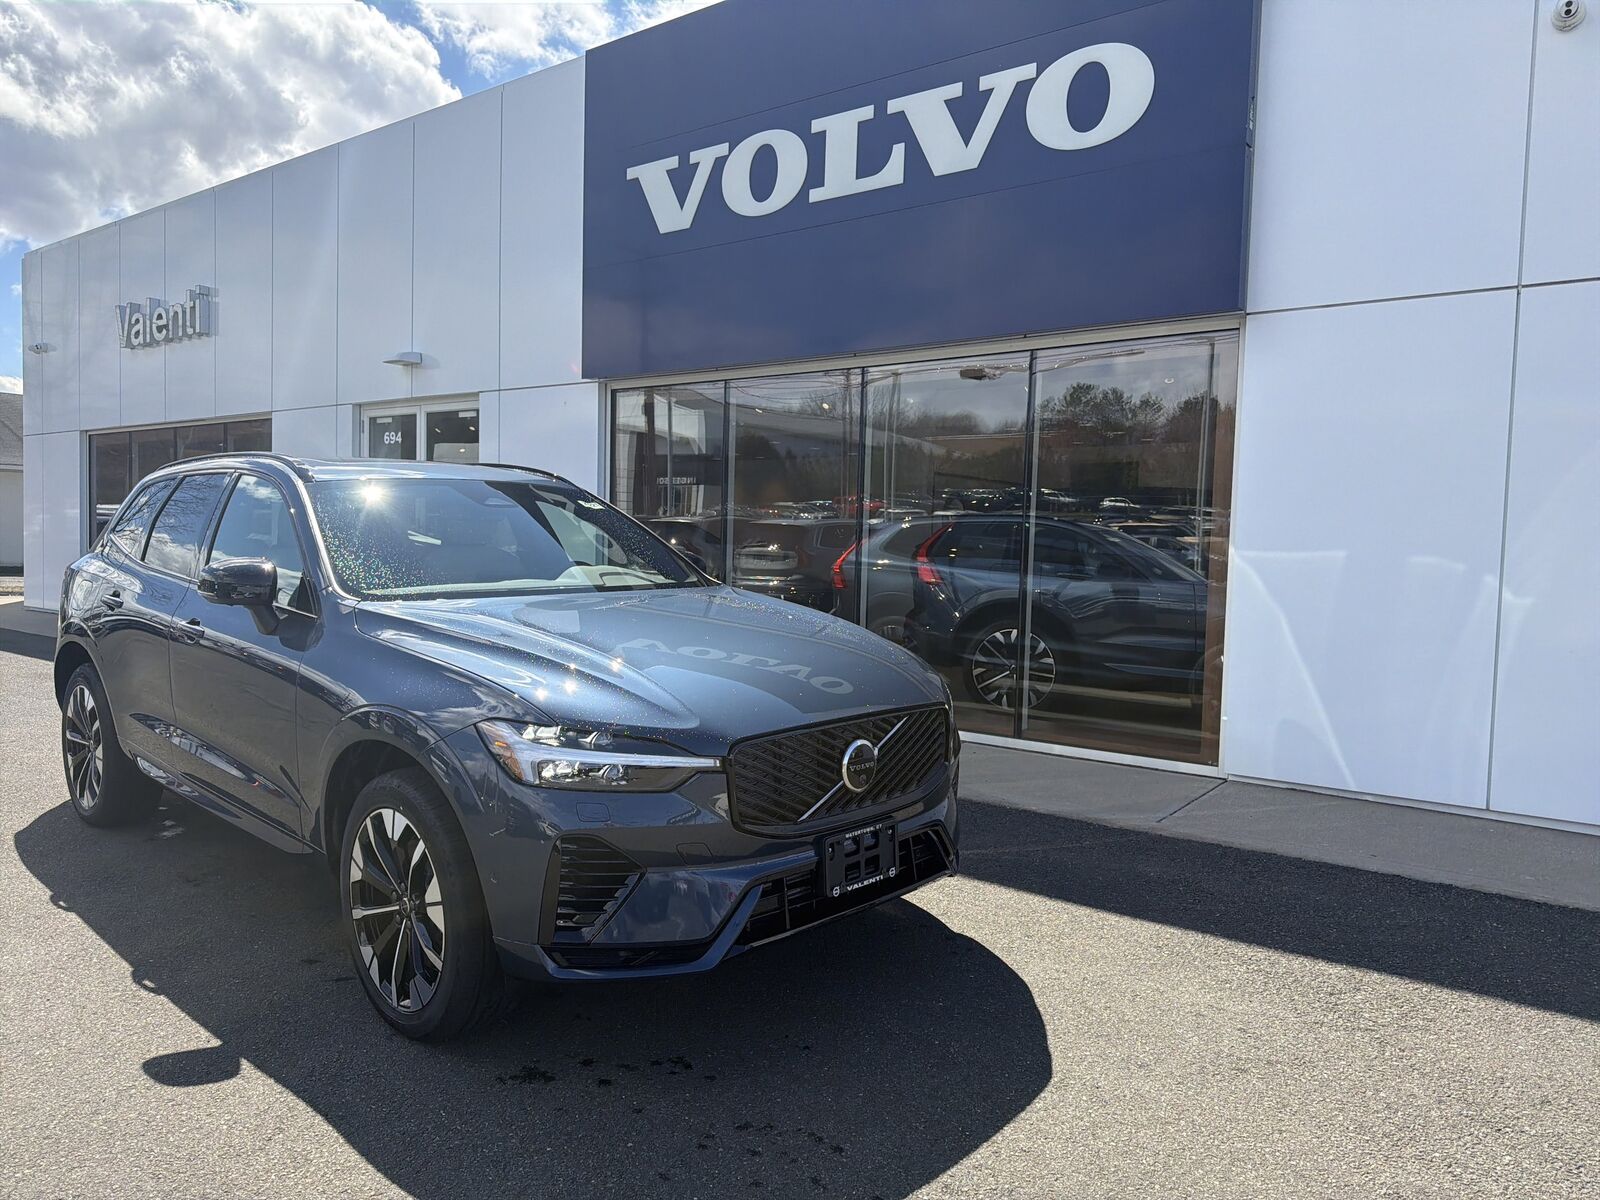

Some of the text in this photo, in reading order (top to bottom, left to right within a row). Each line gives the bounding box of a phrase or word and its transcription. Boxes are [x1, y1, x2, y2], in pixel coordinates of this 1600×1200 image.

[626, 42, 1155, 234] VOLVO
[114, 285, 206, 349] Valenti
[383, 431, 402, 444] 694
[849, 761, 875, 772] VOLVO
[847, 874, 884, 891] VALENTI
